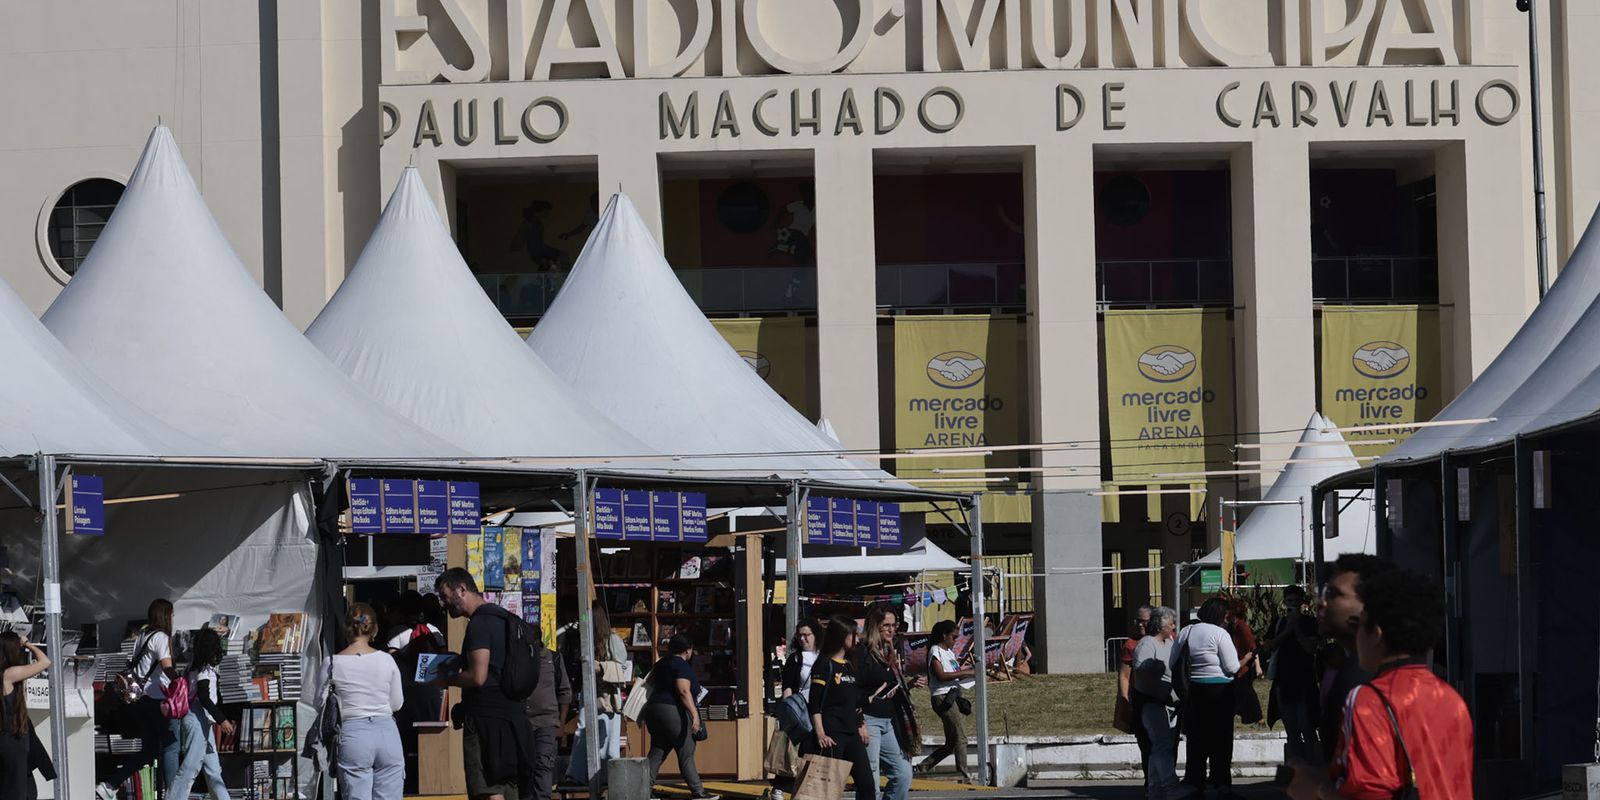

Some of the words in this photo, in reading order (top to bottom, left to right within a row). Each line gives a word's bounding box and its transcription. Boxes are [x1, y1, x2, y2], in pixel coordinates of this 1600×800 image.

[379, 96, 569, 148] PAULO
[659, 86, 965, 140] MACHADO
[1056, 82, 1126, 132] DE
[1216, 78, 1521, 129] CARVALHO
[1122, 386, 1215, 406] mercado
[1336, 384, 1427, 402] mercado
[909, 395, 1003, 411] mercado
[1360, 402, 1403, 419] livre
[935, 413, 978, 429] livre
[1147, 406, 1191, 422] livre
[924, 433, 988, 446] ARENA
[1139, 425, 1202, 440] ARENA
[1175, 520, 1182, 528] 2
